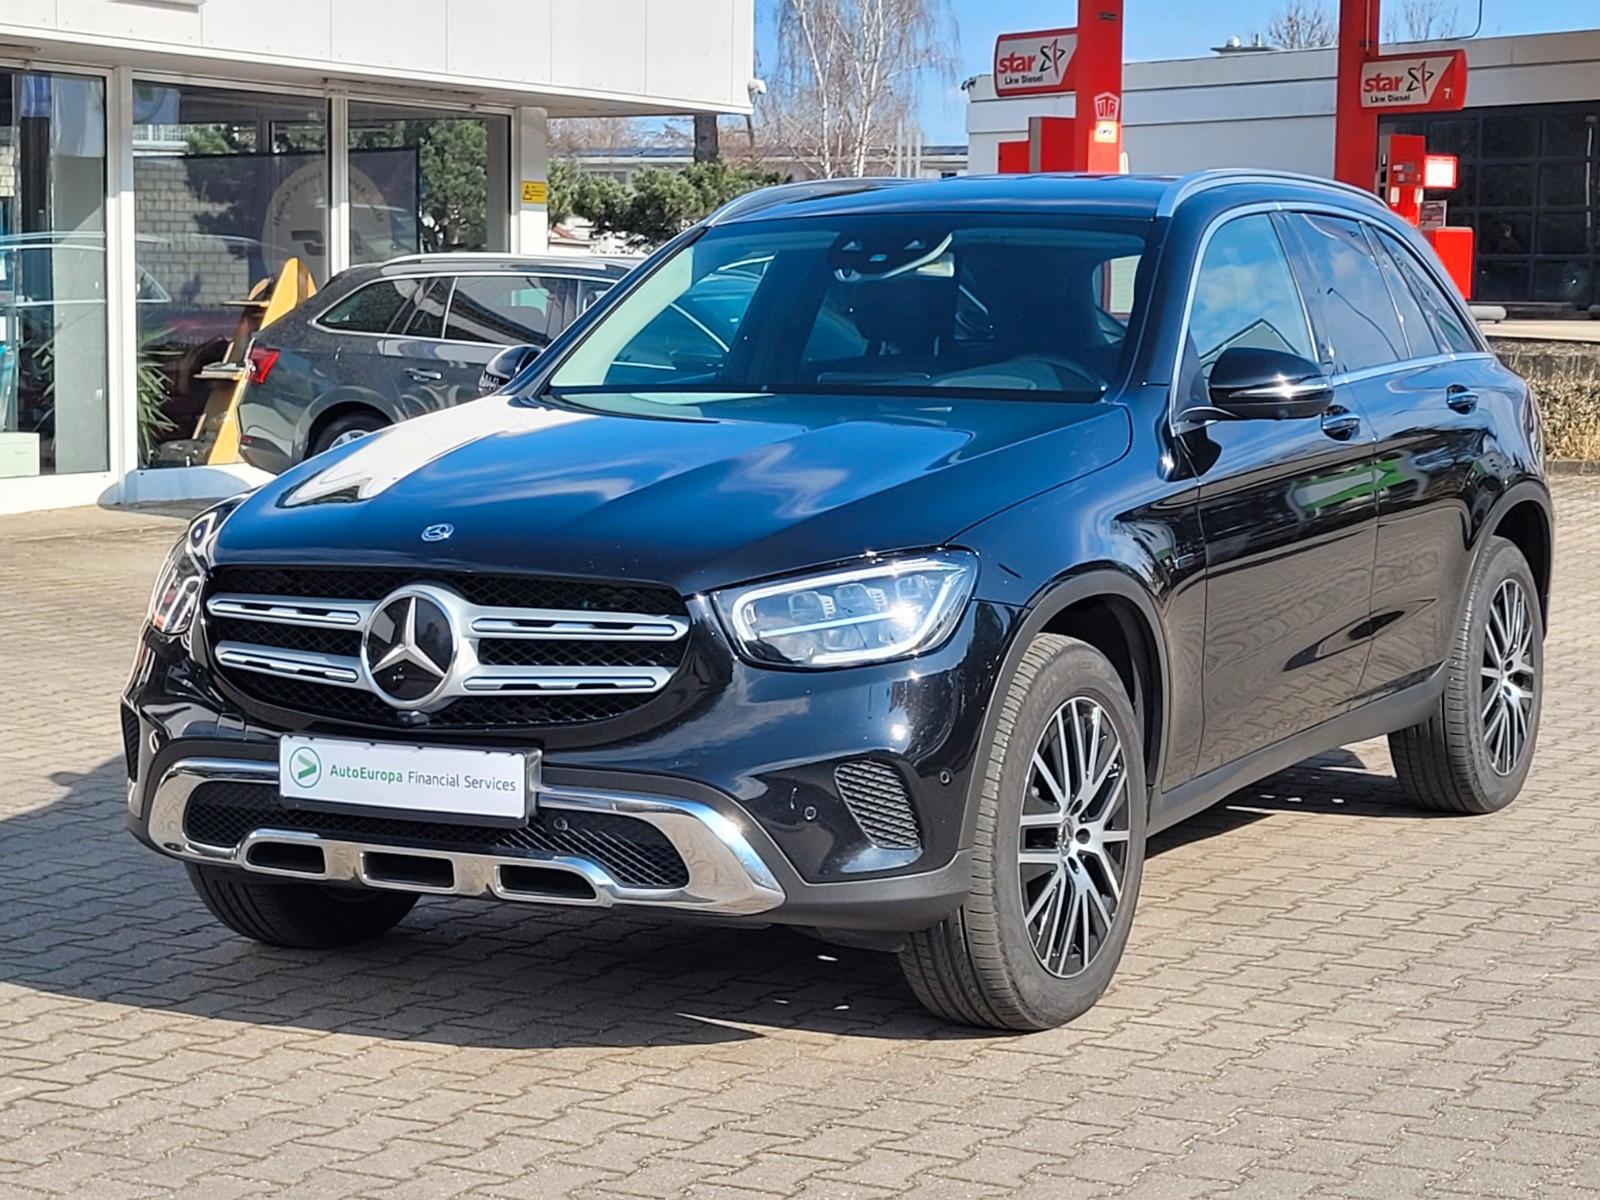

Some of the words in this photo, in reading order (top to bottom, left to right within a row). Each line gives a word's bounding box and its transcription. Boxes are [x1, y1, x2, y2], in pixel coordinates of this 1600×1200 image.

[998, 51, 1036, 74] star
[1020, 74, 1044, 84] Diesel
[1362, 72, 1404, 93] star
[1370, 95, 1386, 104] Lkw
[1387, 94, 1411, 103] Diesel
[1443, 87, 1452, 100] 7
[329, 763, 403, 784] AutoEuropa
[408, 771, 460, 788] Financial
[464, 776, 516, 792] Services
